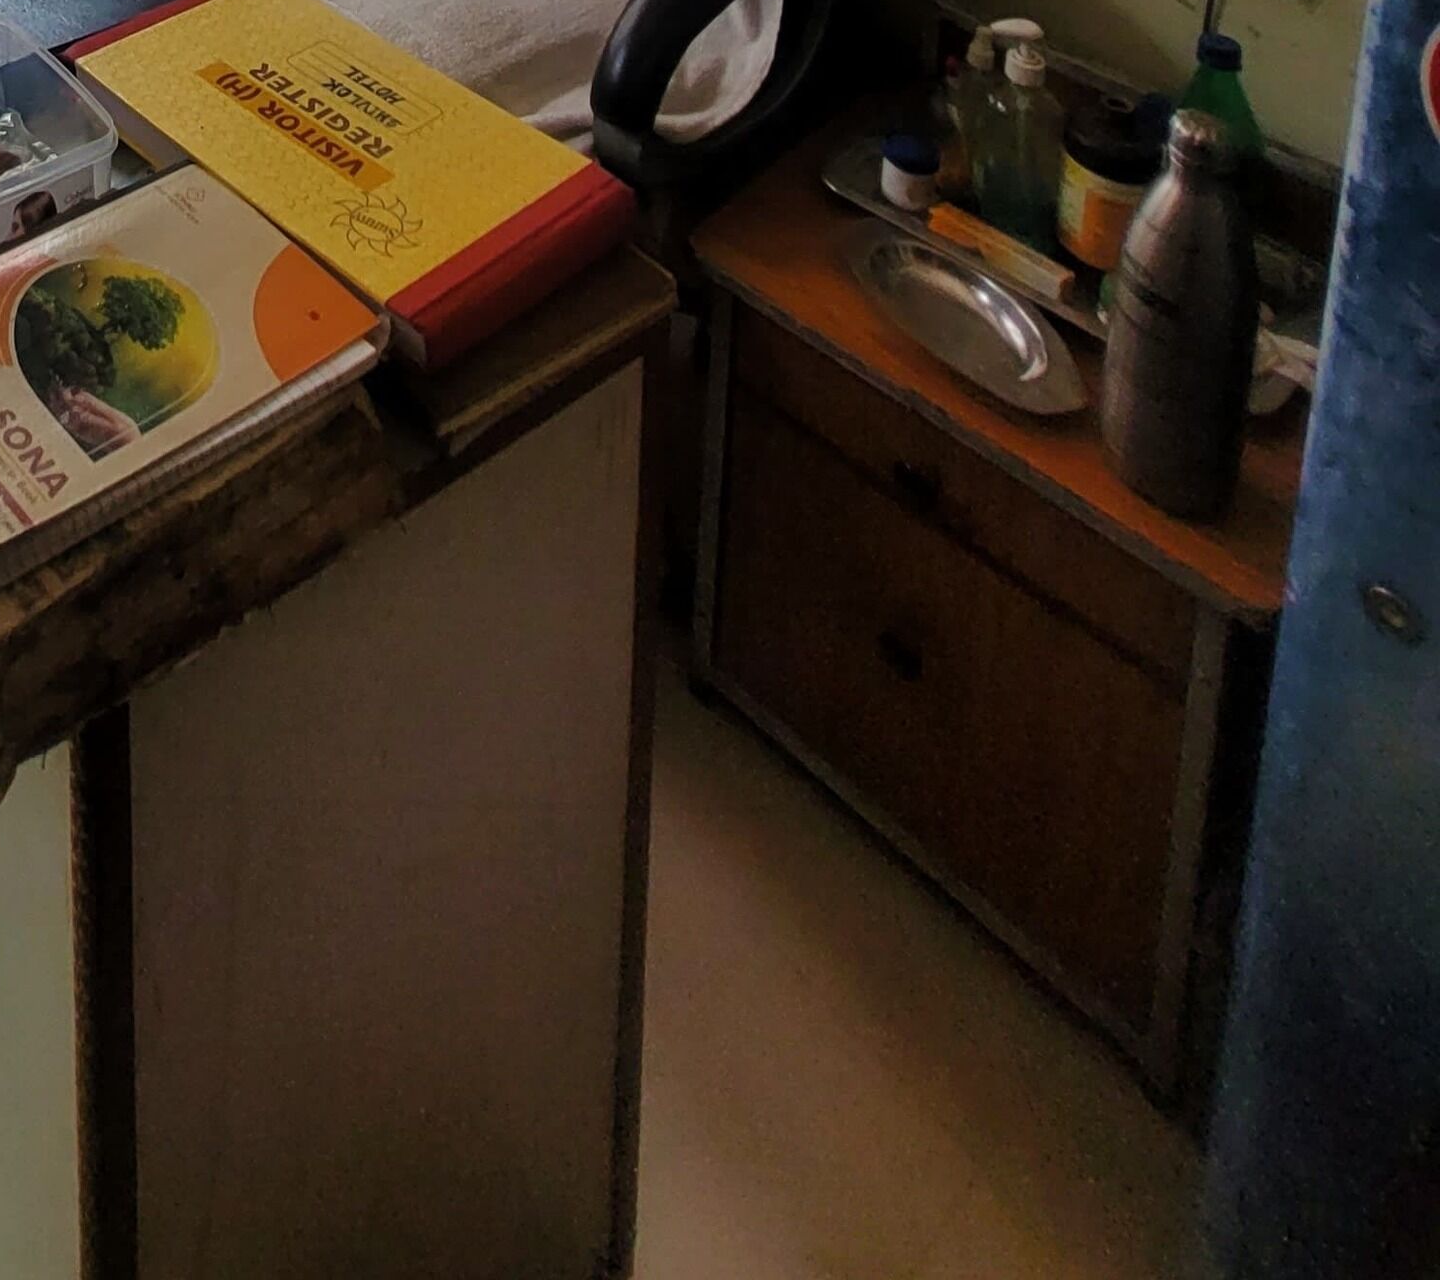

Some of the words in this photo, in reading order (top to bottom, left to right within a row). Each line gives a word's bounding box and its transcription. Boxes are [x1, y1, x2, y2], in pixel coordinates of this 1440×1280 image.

[215, 72, 261, 102] (H)
[320, 76, 403, 129] SHIVLOK
[342, 64, 405, 106] HOTEL
[248, 61, 393, 159] REGISTER
[257, 99, 364, 178] VISITOR
[351, 208, 400, 239] Sunny
